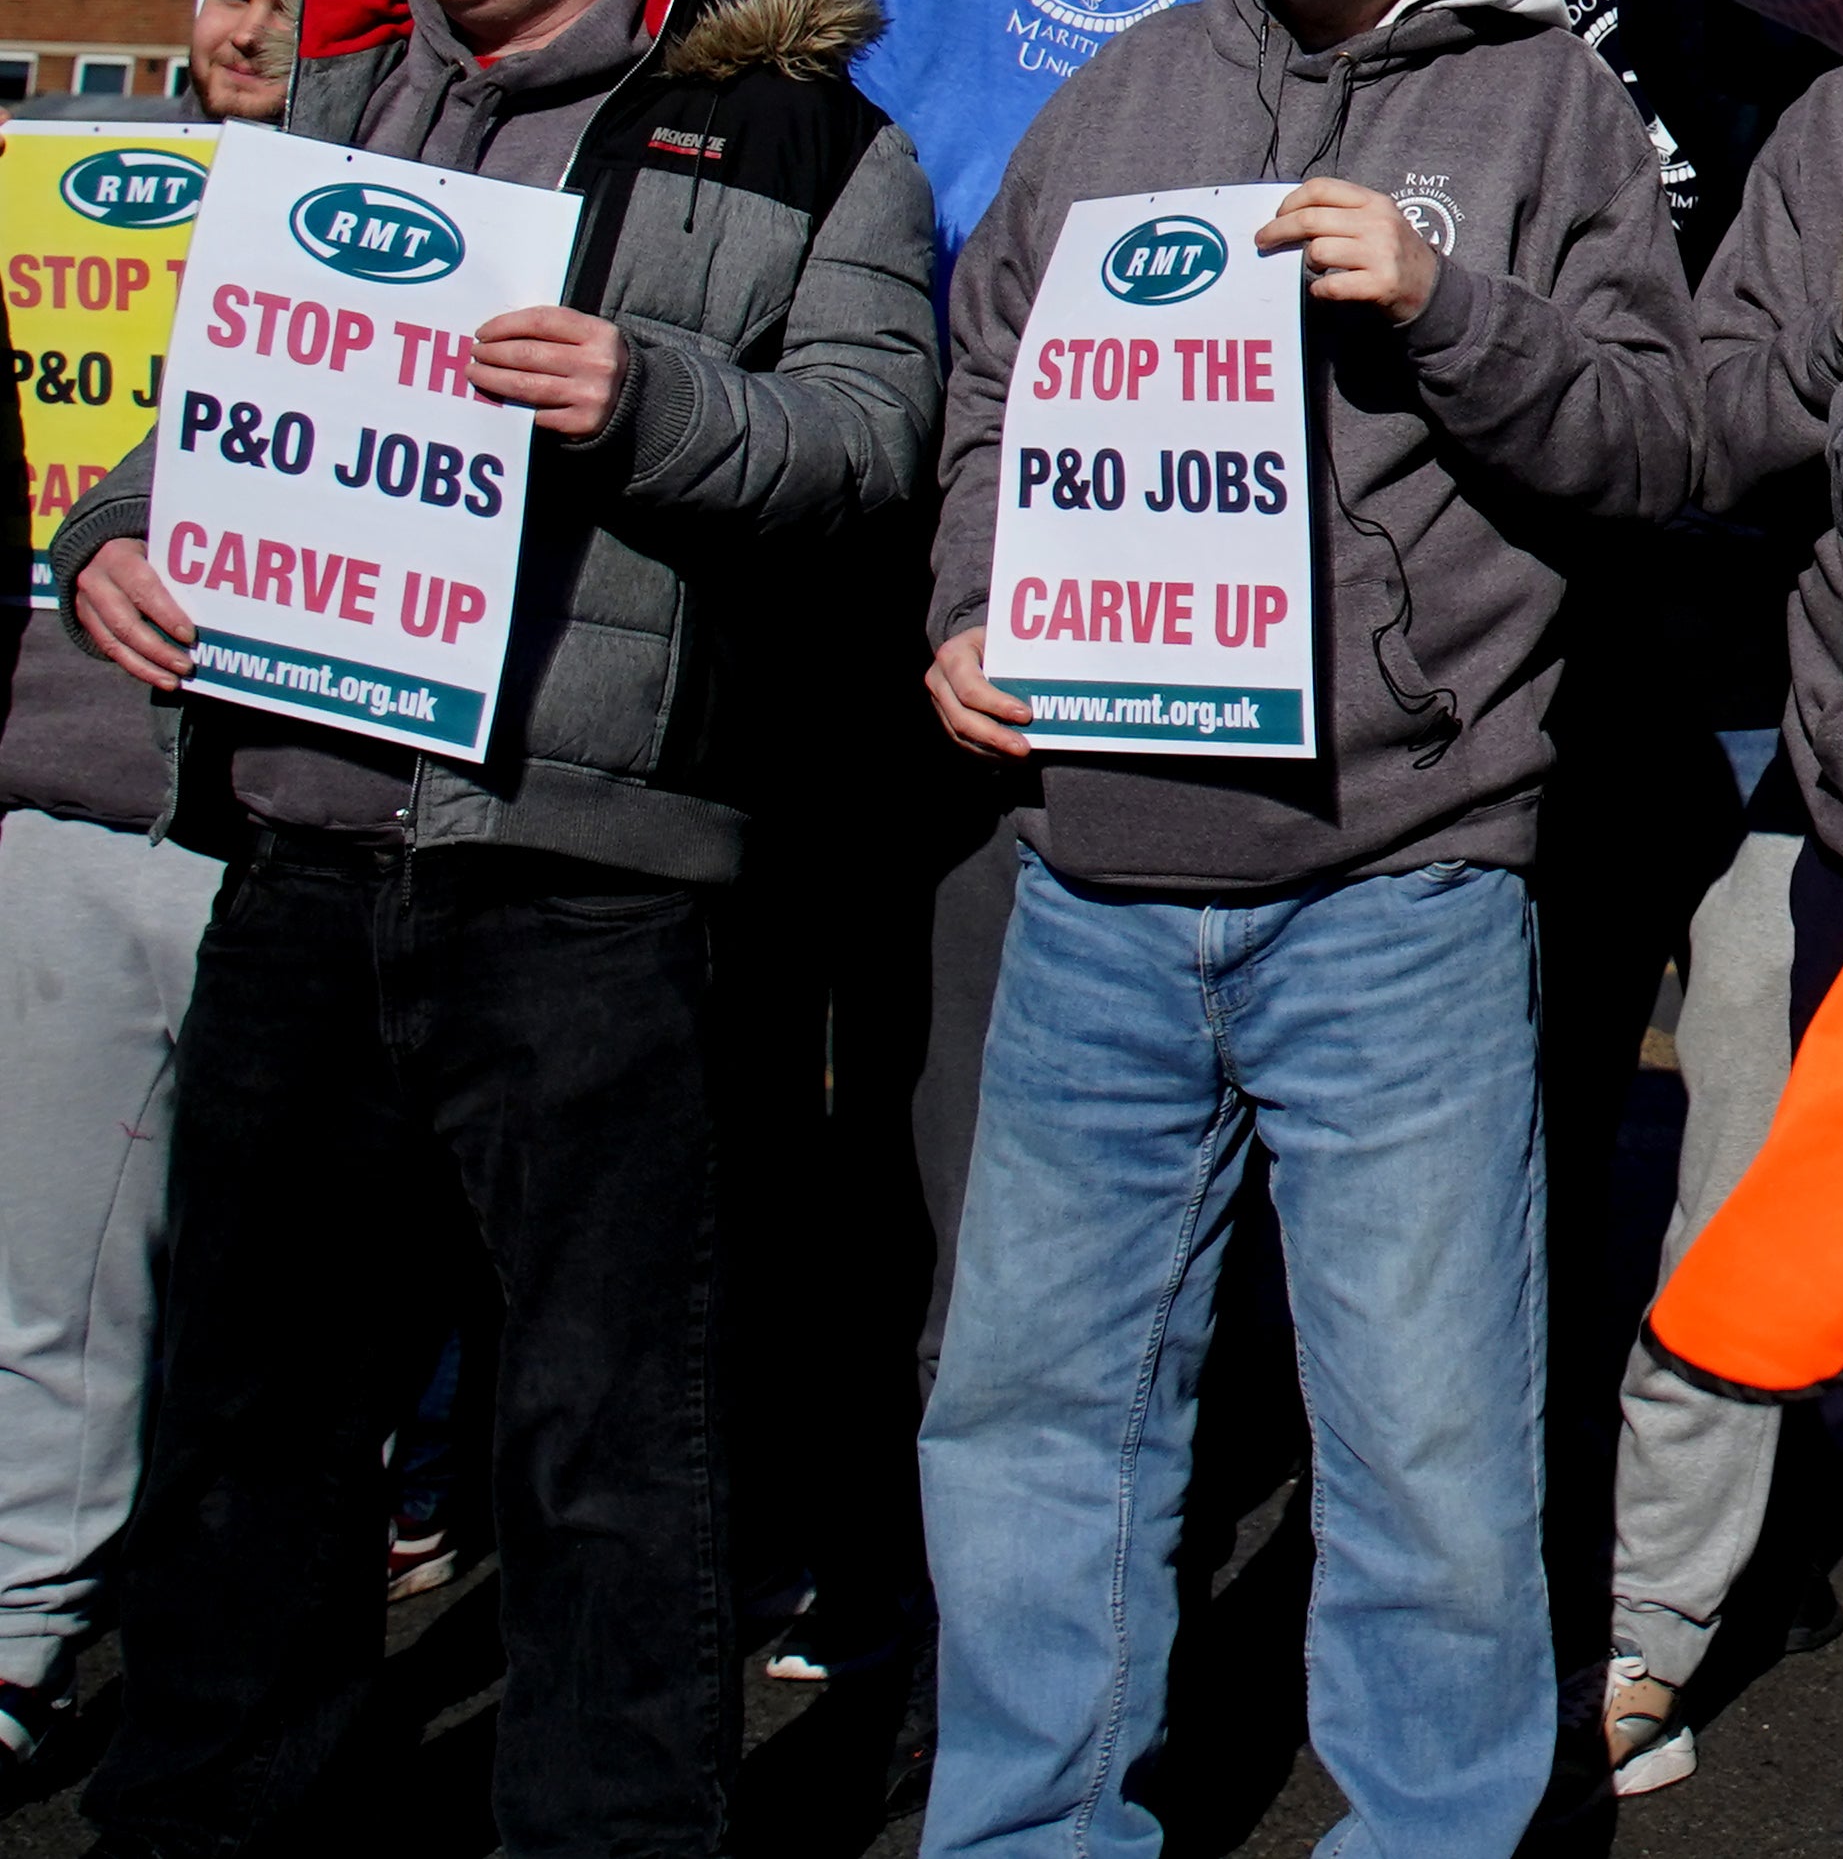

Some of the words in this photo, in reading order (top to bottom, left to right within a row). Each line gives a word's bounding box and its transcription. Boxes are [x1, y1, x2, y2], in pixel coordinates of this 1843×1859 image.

[1006, 8, 1099, 58] MARITI
[96, 174, 189, 205] RMT
[1390, 187, 1415, 201] VER
[1419, 187, 1466, 222] SHIPPING
[1405, 172, 1450, 188] RMT
[327, 212, 431, 259] RMT
[1125, 244, 1205, 281] RMT
[8, 253, 150, 311] STOP
[206, 282, 375, 372] STOP
[394, 320, 505, 409] TH
[1031, 338, 1159, 403] STOP
[1174, 339, 1276, 403] THE
[179, 389, 316, 476] P&O
[334, 426, 505, 519] JOBS
[1017, 447, 1127, 512] P&O
[1144, 449, 1289, 516] JOBS
[166, 520, 381, 625] CARVE
[400, 570, 487, 644] UP
[1010, 576, 1193, 646] CARVE
[1214, 584, 1289, 649] UP
[189, 641, 439, 722] www.rmt.org.uk
[1030, 692, 1261, 734] www.rmt.org.uk
